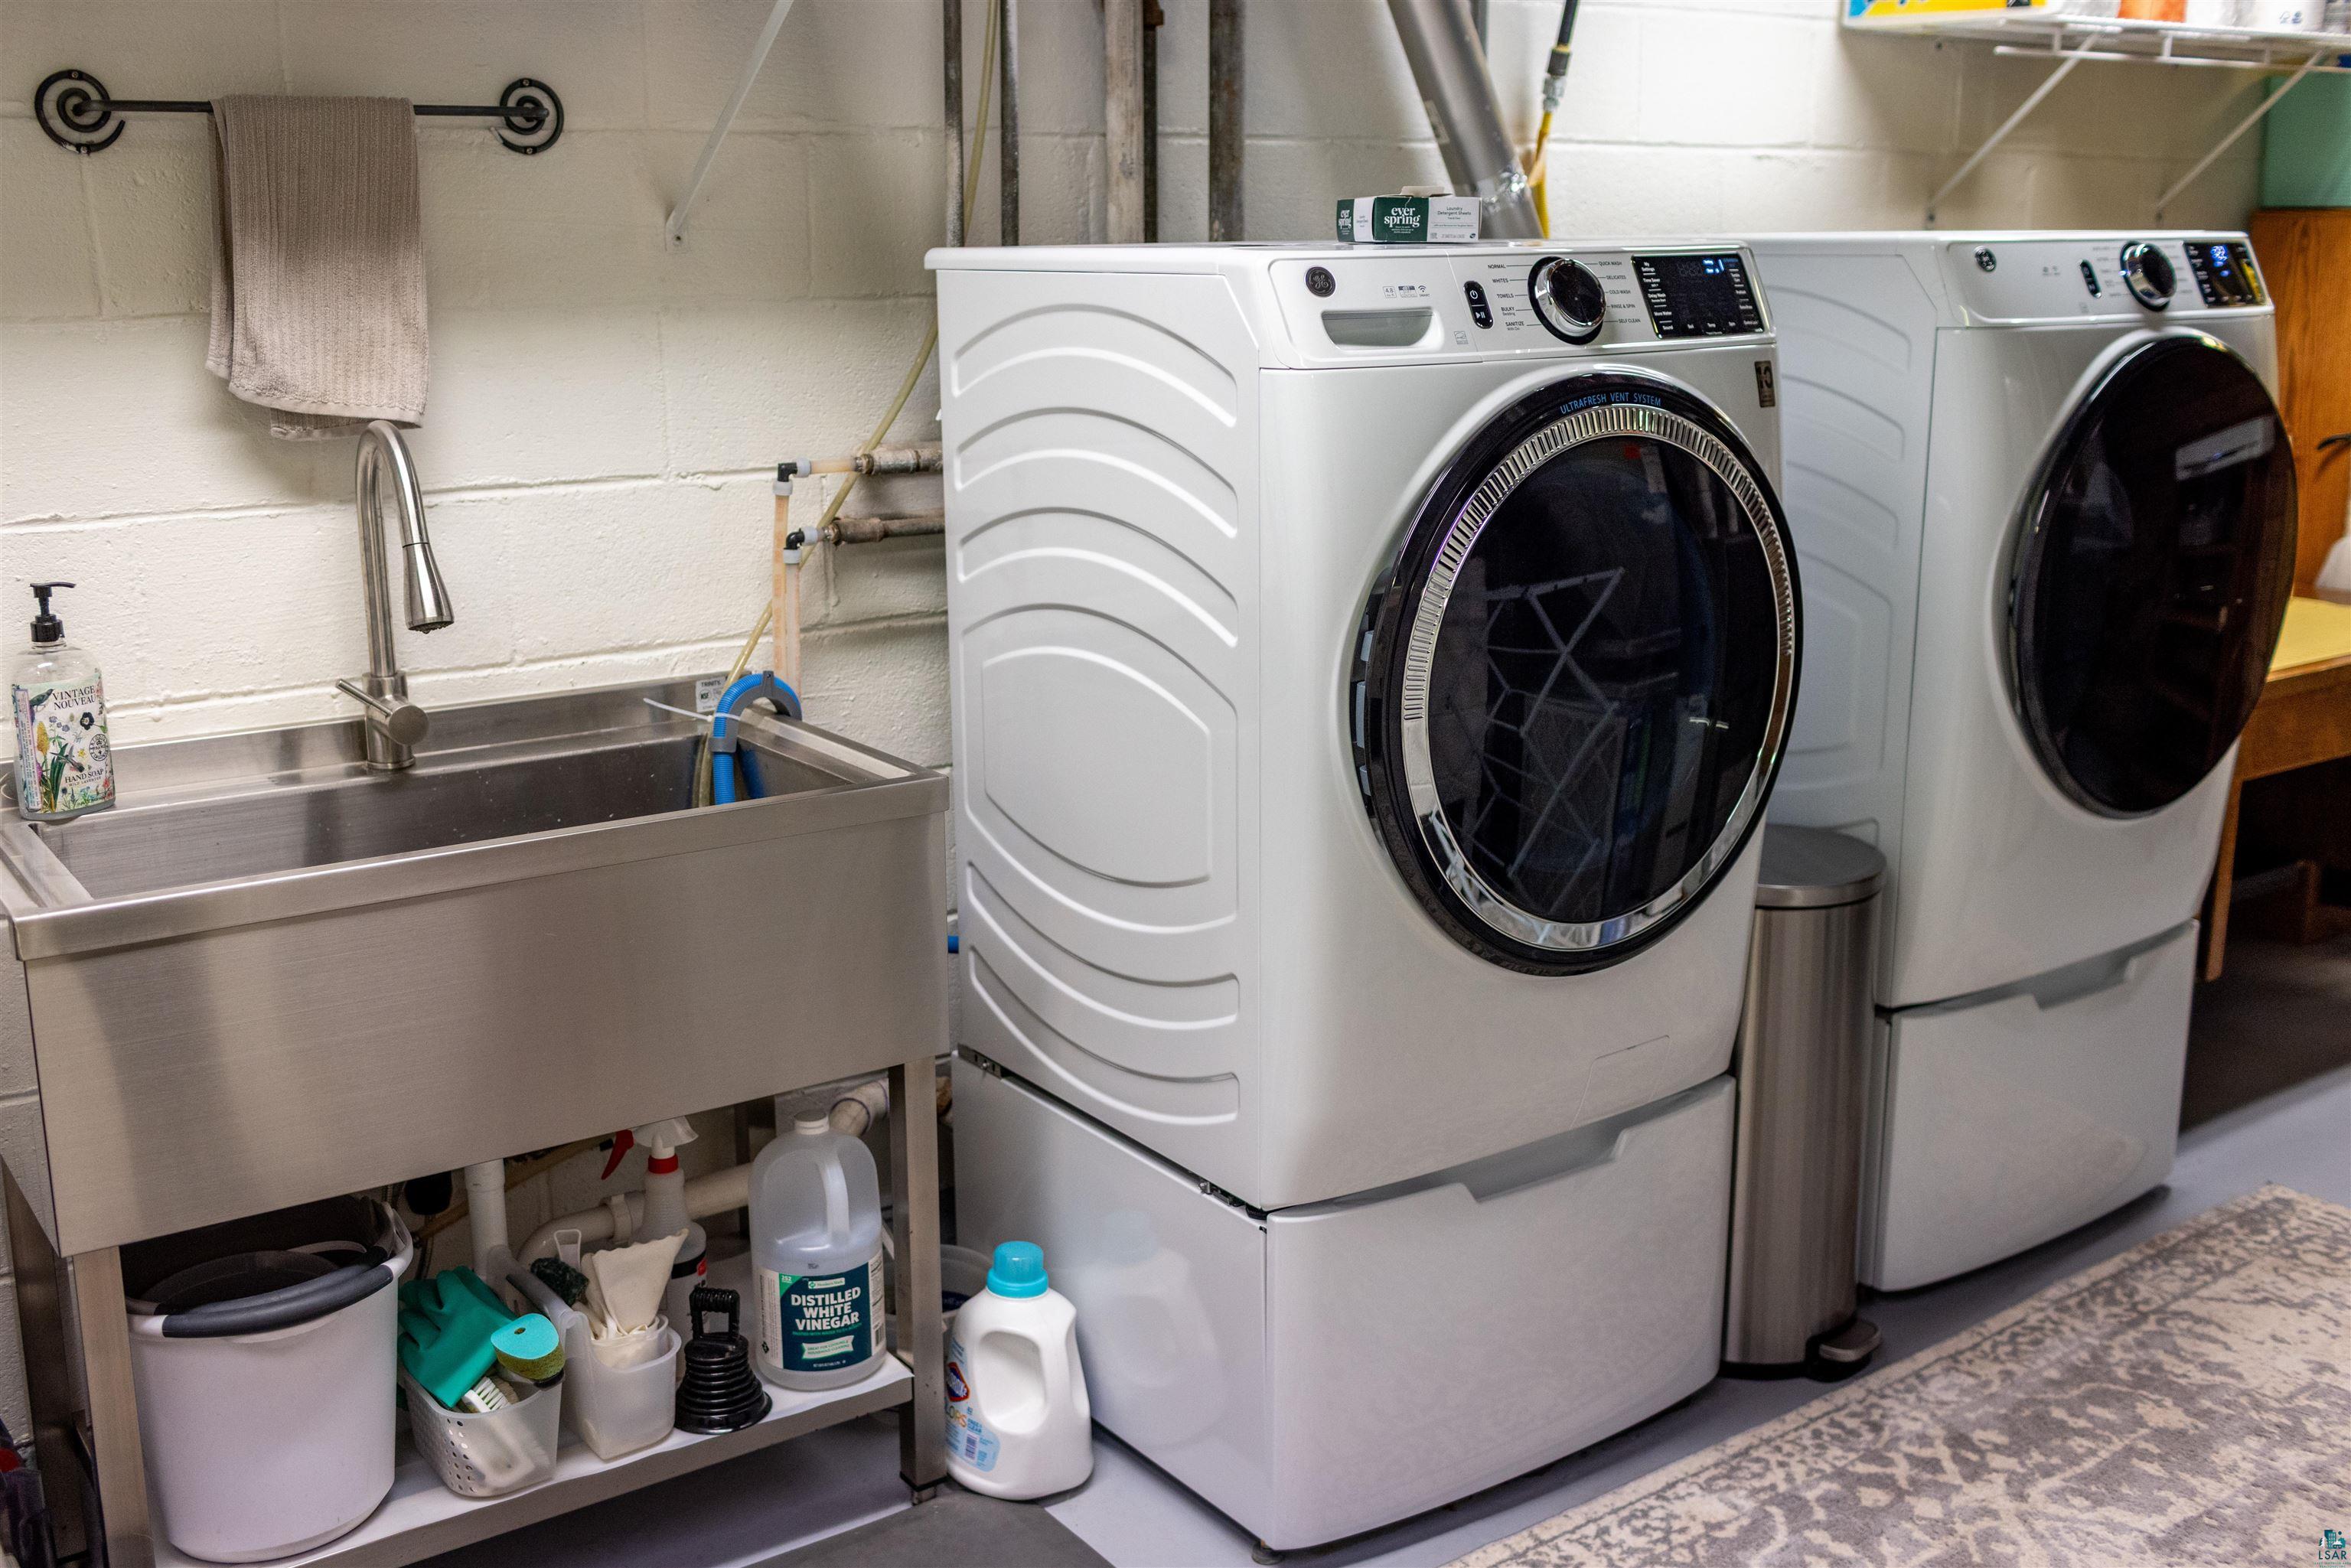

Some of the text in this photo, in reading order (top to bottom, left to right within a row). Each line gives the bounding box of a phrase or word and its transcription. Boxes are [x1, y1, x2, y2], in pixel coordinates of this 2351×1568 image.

[1391, 207, 1415, 216] ever
[1384, 214, 1420, 228] spring
[1560, 392, 1661, 414] ULTRAFRESH VENT SYSTEM
[52, 685, 96, 701] VINTAGE
[54, 695, 96, 710] NOUVEAU
[65, 768, 104, 783] HAND SOAP
[791, 1286, 861, 1306] DISTILLED
[804, 1302, 852, 1318] WHITE
[795, 1312, 859, 1331] VINEGAR
